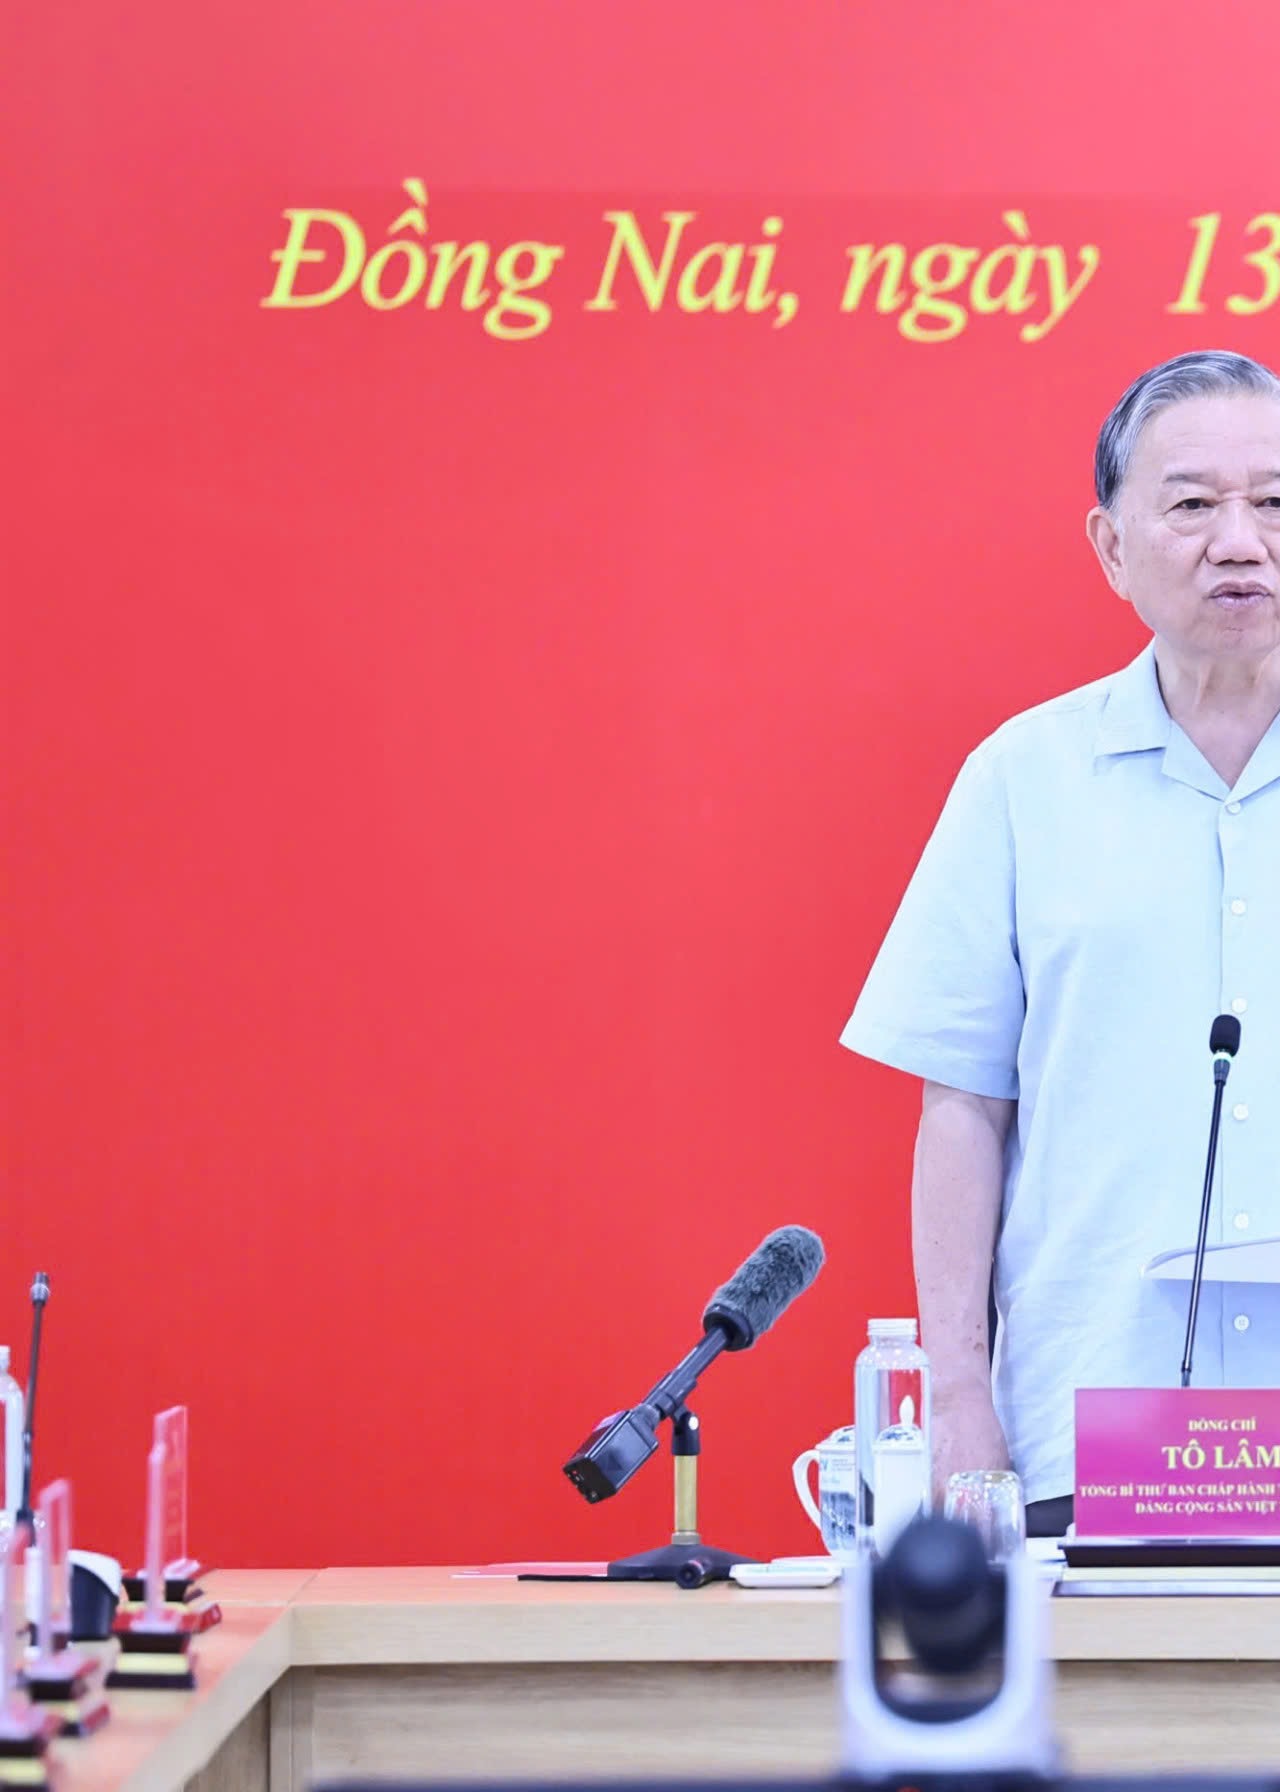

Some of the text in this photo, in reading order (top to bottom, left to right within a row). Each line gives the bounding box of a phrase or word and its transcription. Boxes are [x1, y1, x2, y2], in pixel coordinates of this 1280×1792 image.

[262, 178, 564, 341] Đồng
[586, 210, 800, 328] Nai,
[840, 210, 1100, 342] ngày
[1230, 1416, 1257, 1431] CHÍ
[1161, 1438, 1207, 1470] TÔ
[1119, 1482, 1134, 1497] BÍ
[1136, 1483, 1167, 1496] THƯ
[1168, 1484, 1196, 1496] BAN
[1237, 1481, 1276, 1495] HÀNH
